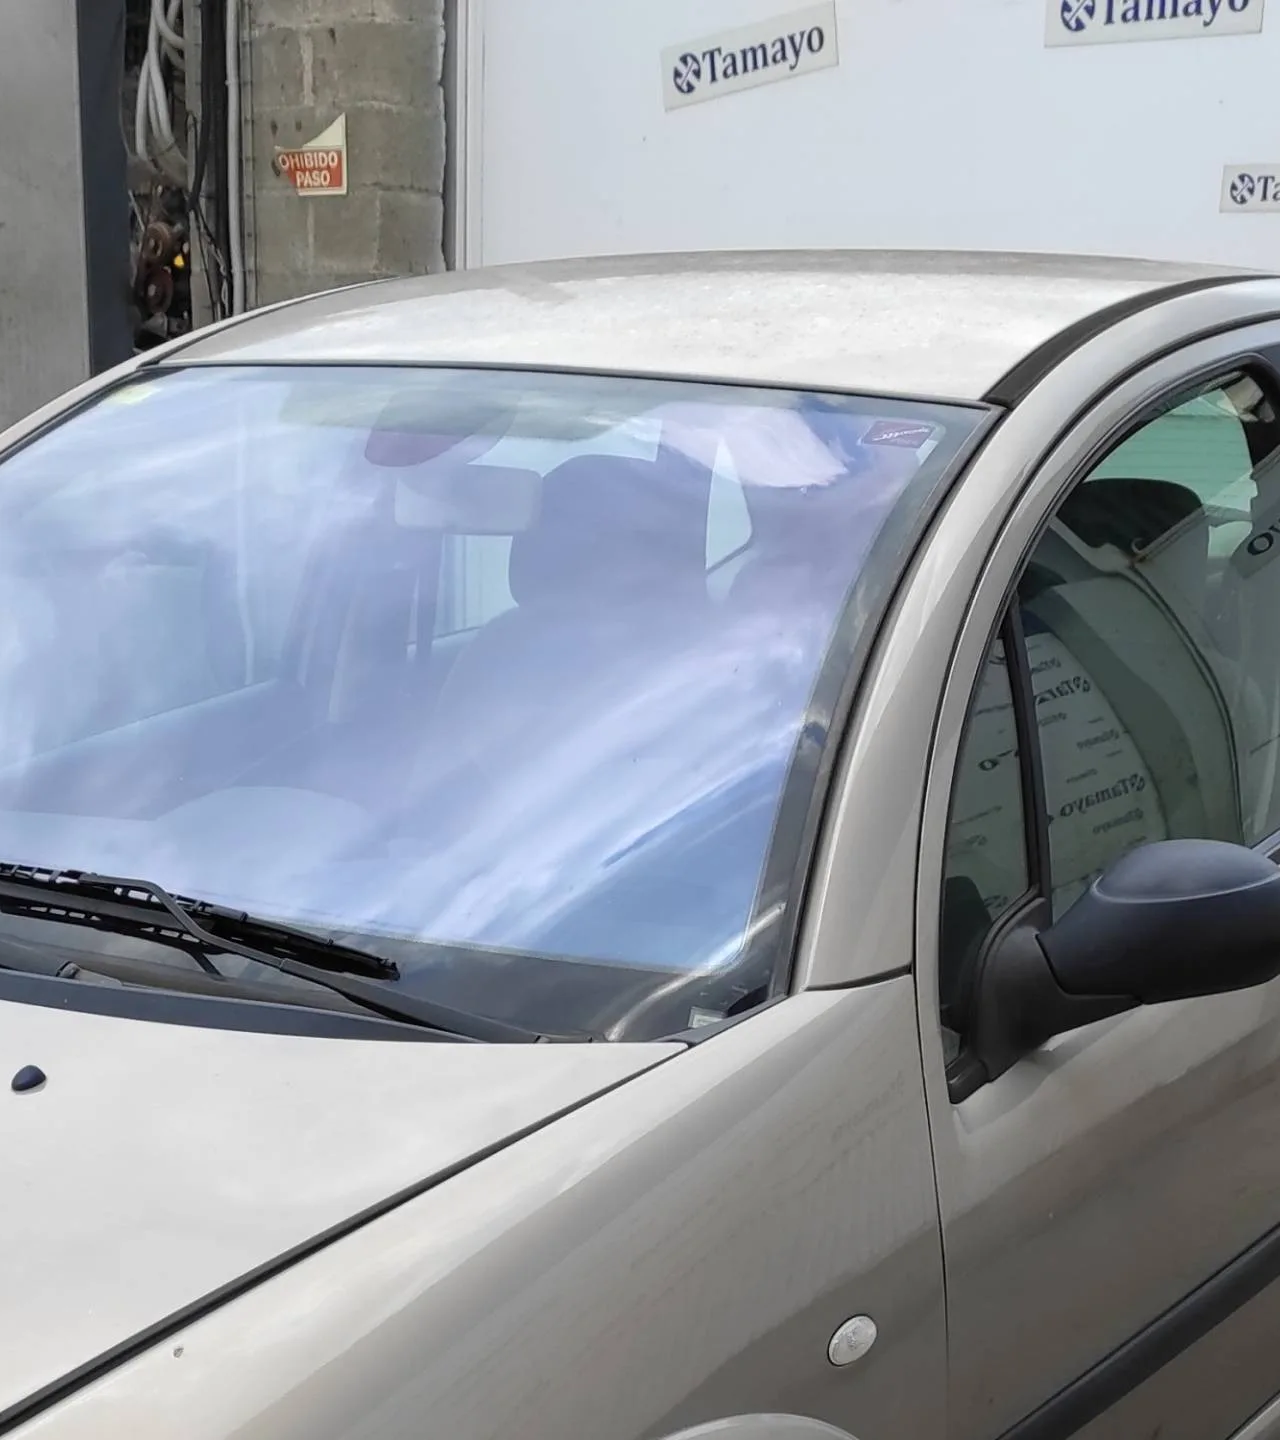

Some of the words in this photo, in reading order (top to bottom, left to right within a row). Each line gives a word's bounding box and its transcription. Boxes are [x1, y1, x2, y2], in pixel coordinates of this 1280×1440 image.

[701, 25, 825, 84] Tamayo
[278, 151, 338, 169] OHIBIDO
[296, 170, 331, 187] PASO
